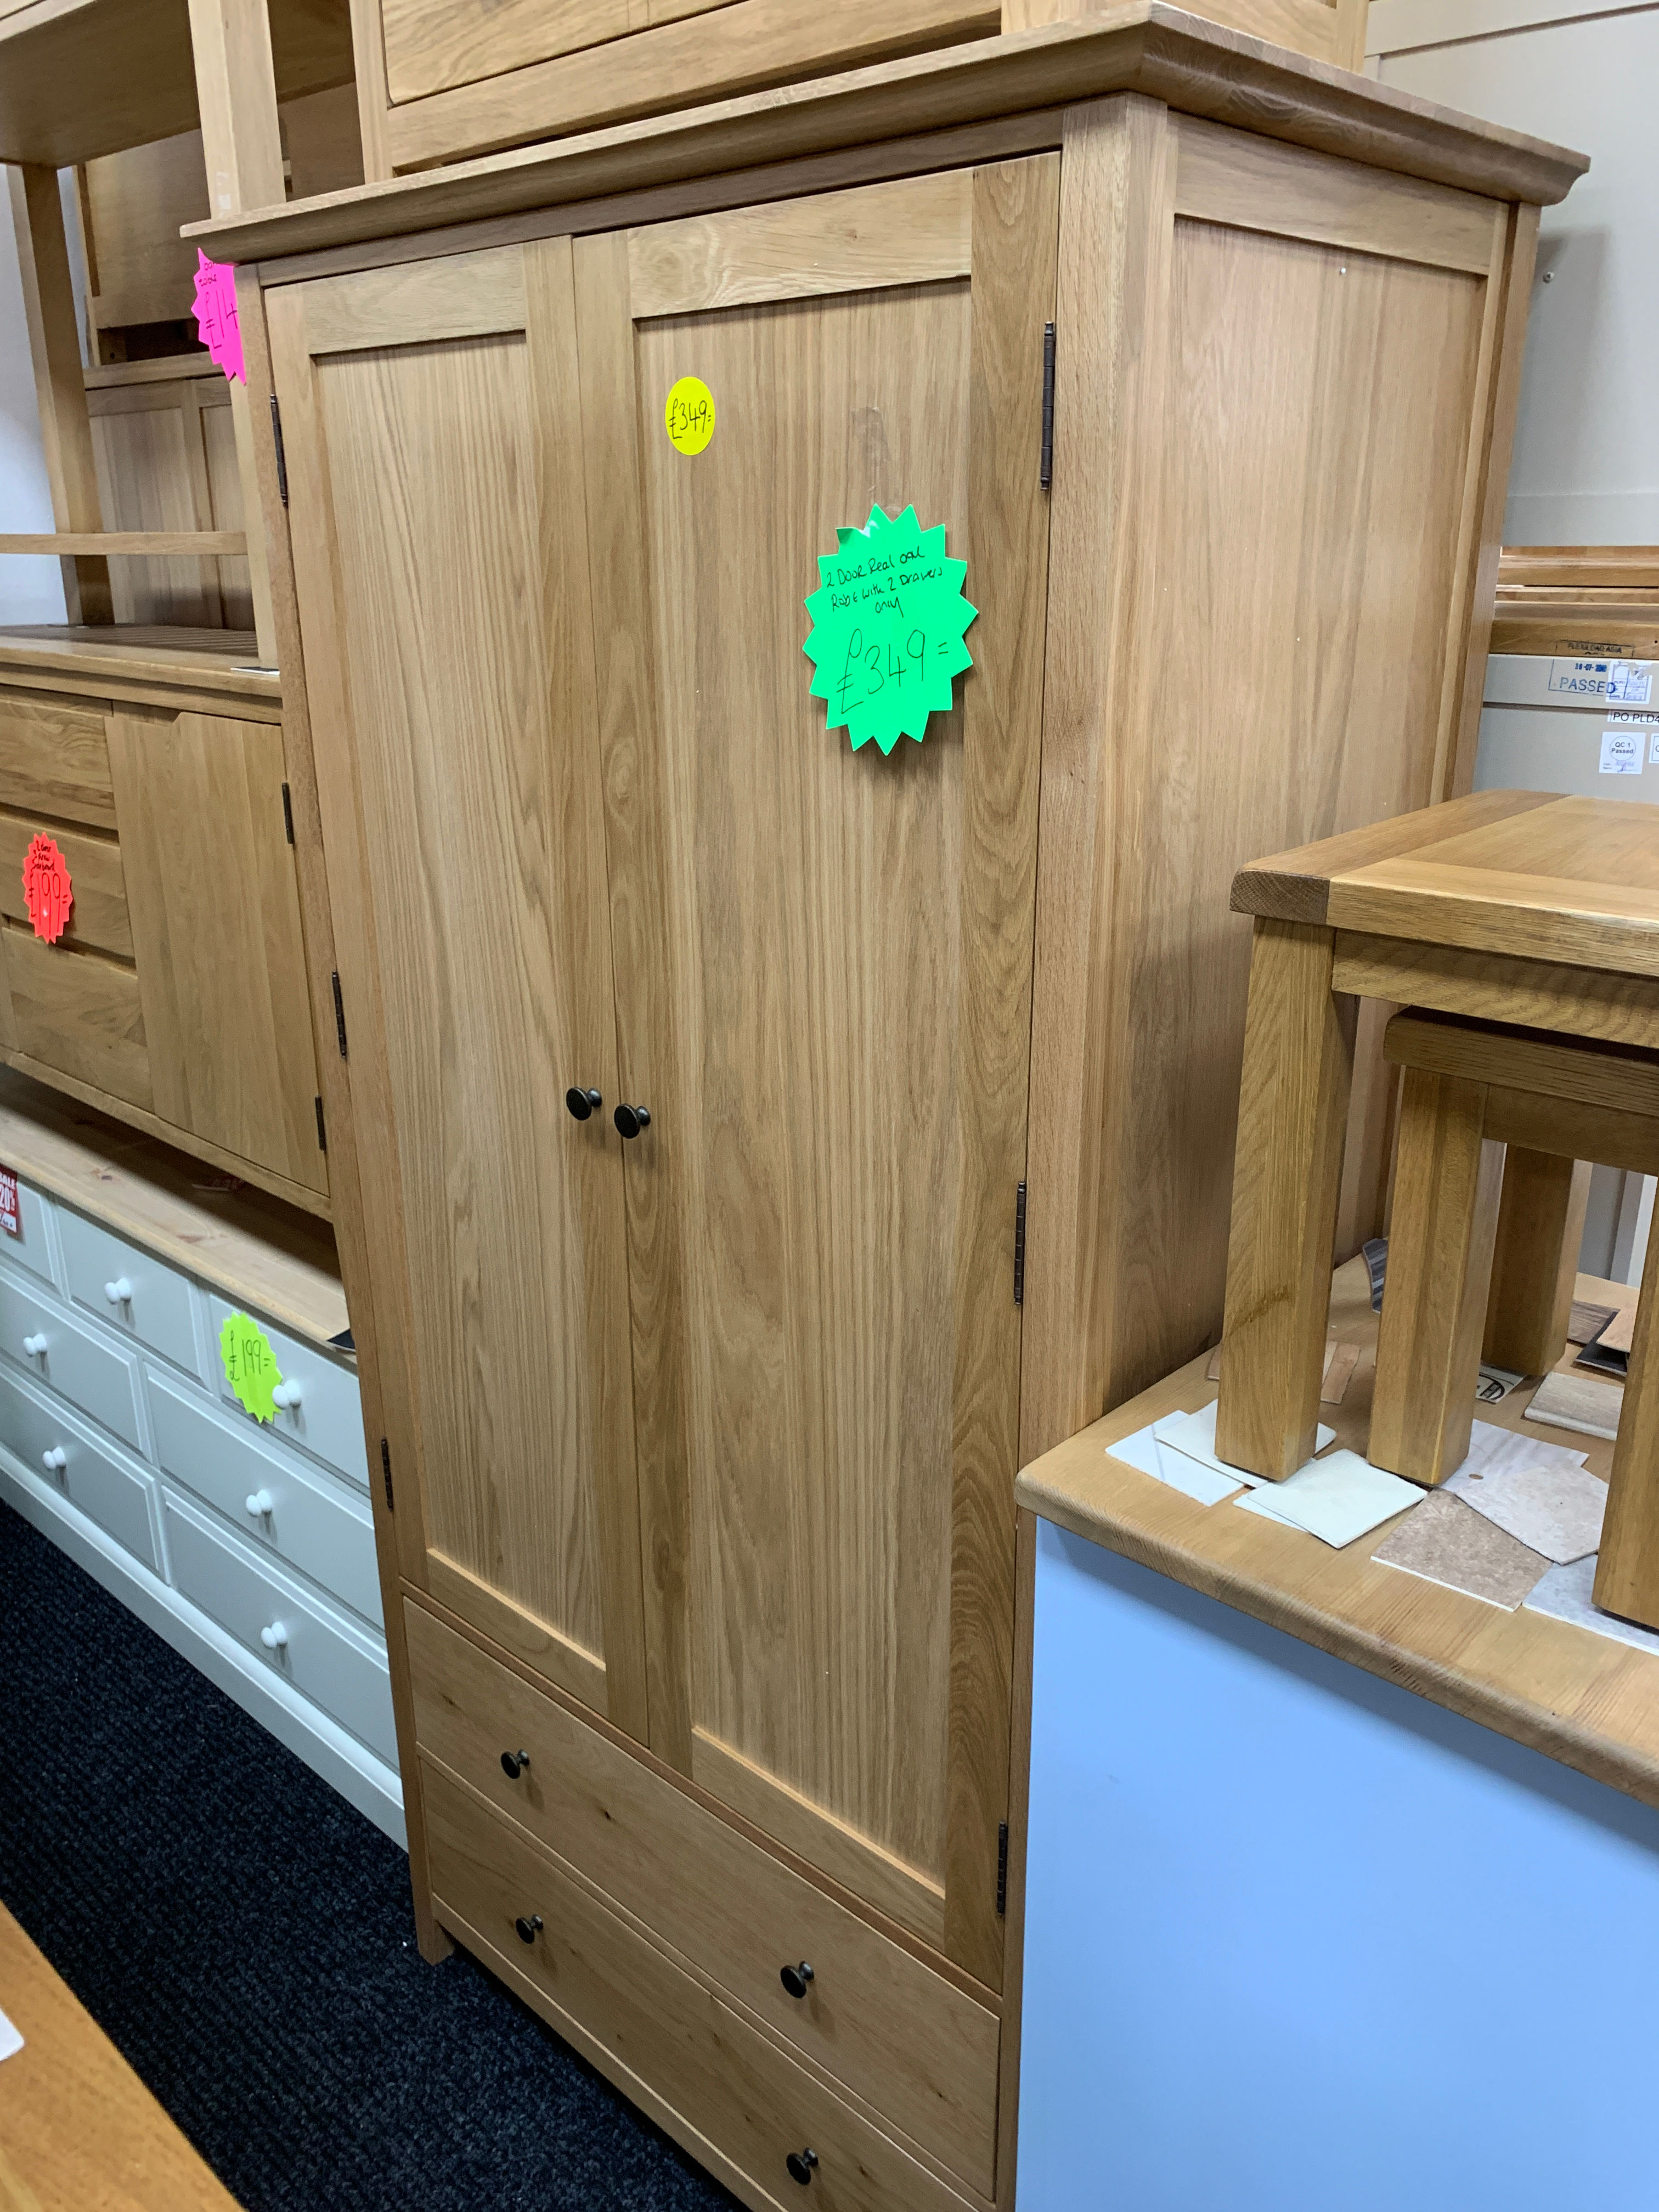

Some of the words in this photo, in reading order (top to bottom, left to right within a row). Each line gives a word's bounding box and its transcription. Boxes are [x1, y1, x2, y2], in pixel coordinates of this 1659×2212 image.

[827, 572, 834, 588] 2
[867, 555, 895, 574] Real
[888, 577, 896, 591] 2
[875, 596, 904, 618] only
[1559, 676, 1616, 694] PASSED
[1613, 712, 1629, 721] PO
